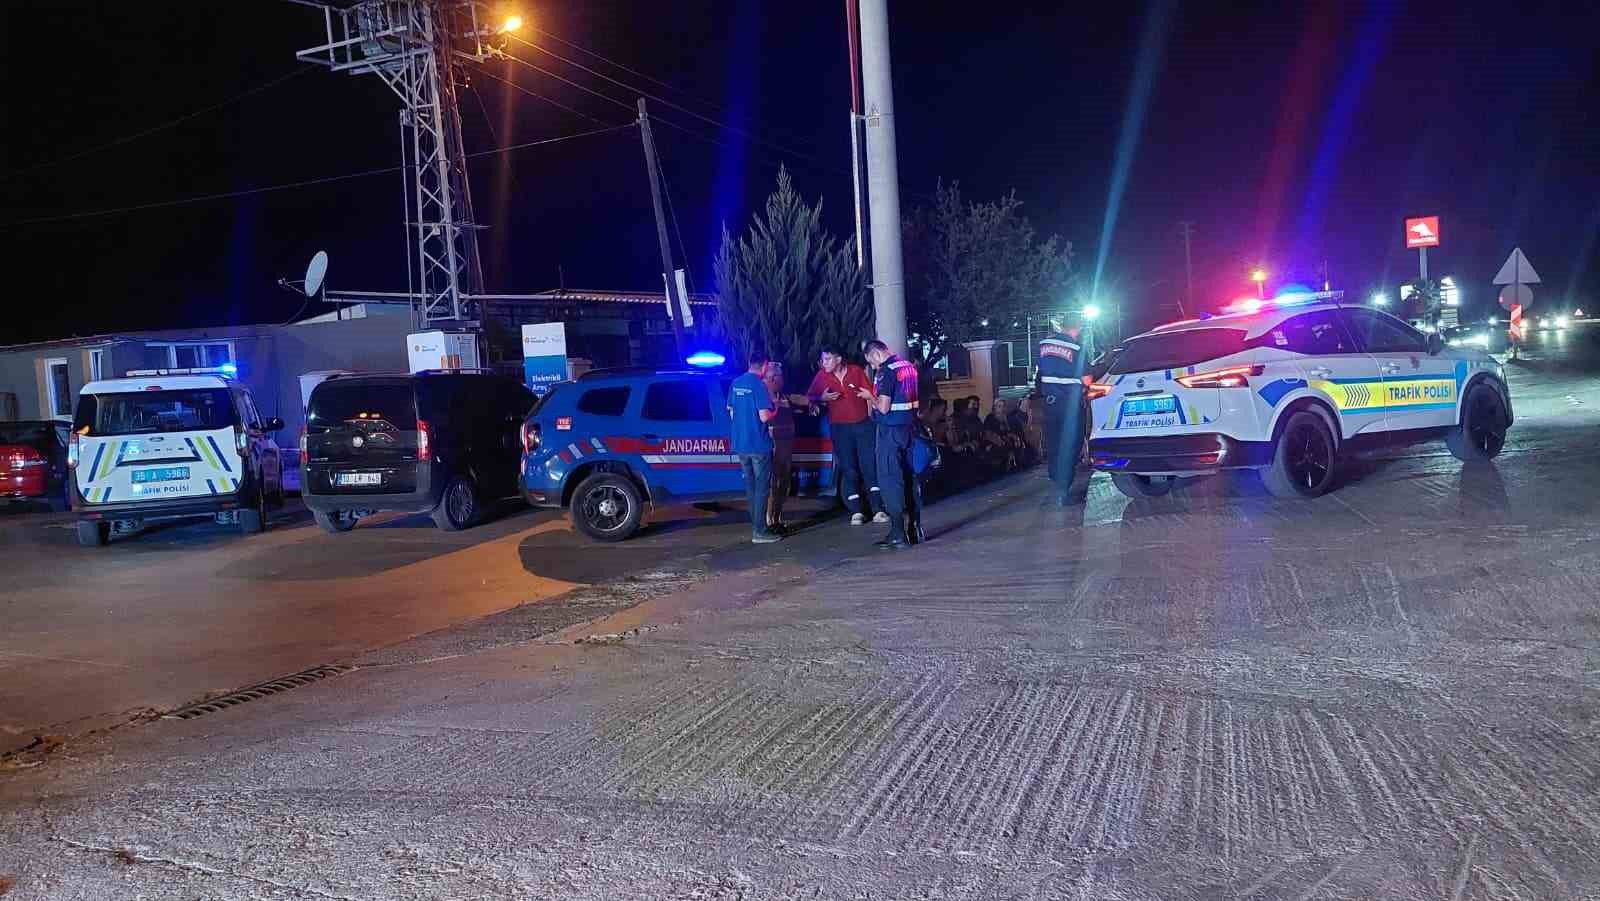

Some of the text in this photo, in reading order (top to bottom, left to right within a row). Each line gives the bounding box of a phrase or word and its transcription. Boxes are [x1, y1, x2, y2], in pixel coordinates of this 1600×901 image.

[1389, 383, 1452, 401] TRAFİK POLİSİ
[662, 439, 726, 453] JANDARMA
